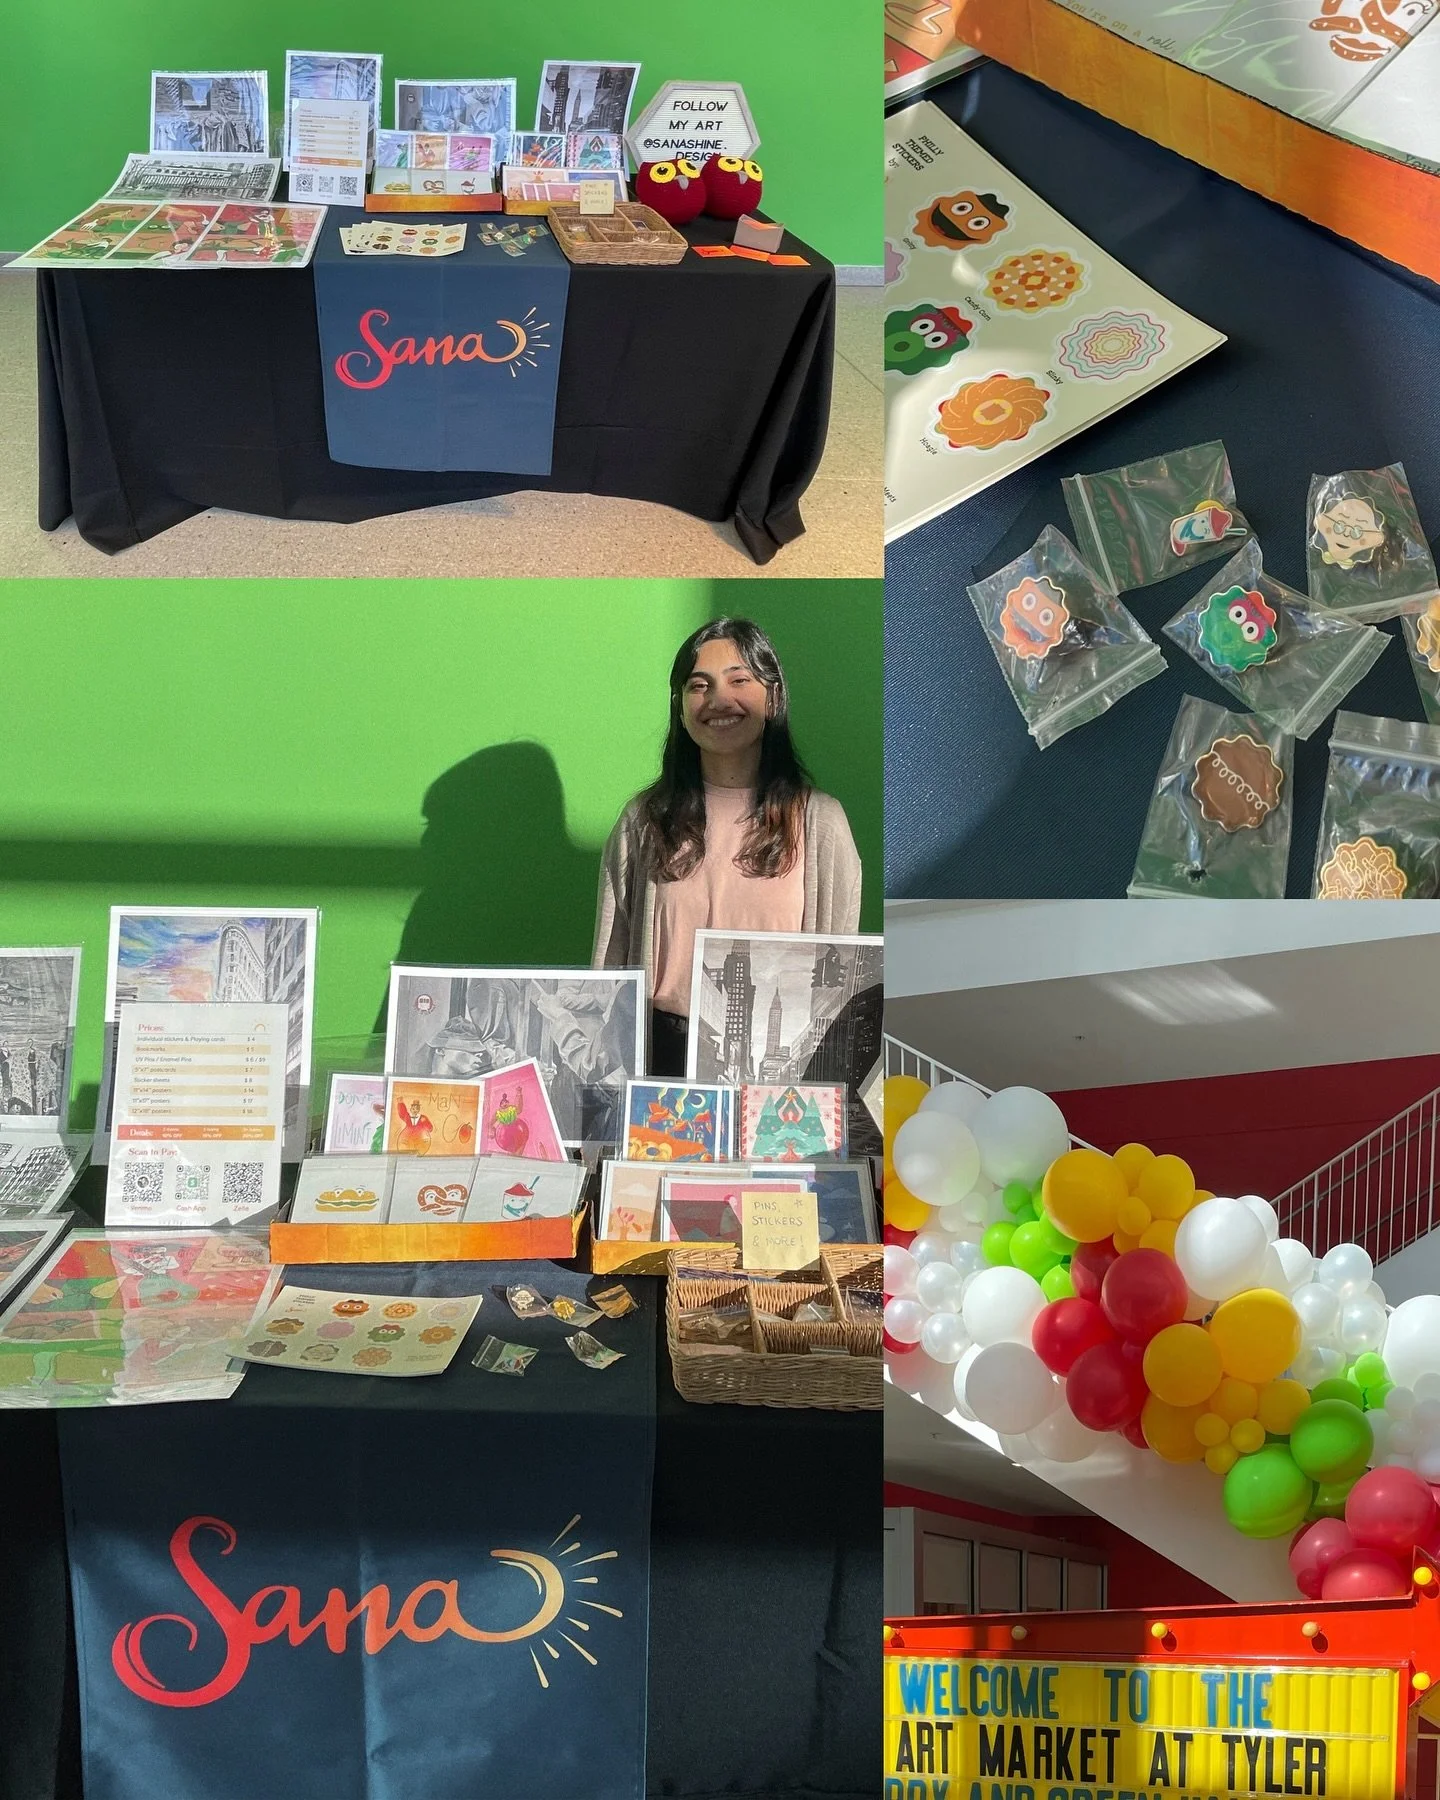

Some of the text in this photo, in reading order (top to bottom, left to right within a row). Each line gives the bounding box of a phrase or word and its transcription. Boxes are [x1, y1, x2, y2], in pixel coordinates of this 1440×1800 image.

[1111, 20, 1129, 31] on
[673, 101, 728, 112] FOLLOW
[669, 120, 723, 131] MY ART
[905, 138, 934, 164] THEMED
[918, 135, 944, 156] PHILLY
[892, 142, 924, 171] STICKERS
[964, 296, 992, 322] Candy Corn
[334, 309, 527, 390] Sana
[1046, 369, 1064, 385] Slinky
[919, 437, 938, 456] Hoagie
[190, 1036, 210, 1044] Playing
[128, 1147, 149, 1156] Scan
[150, 1147, 159, 1156] to
[752, 1215, 803, 1227] STICKERS
[752, 1235, 760, 1247] &
[111, 1515, 564, 1708] Sana
[900, 1663, 1272, 1729] WELCOME TO THE
[896, 1720, 1327, 1796] ART MARKET AT TYLER
